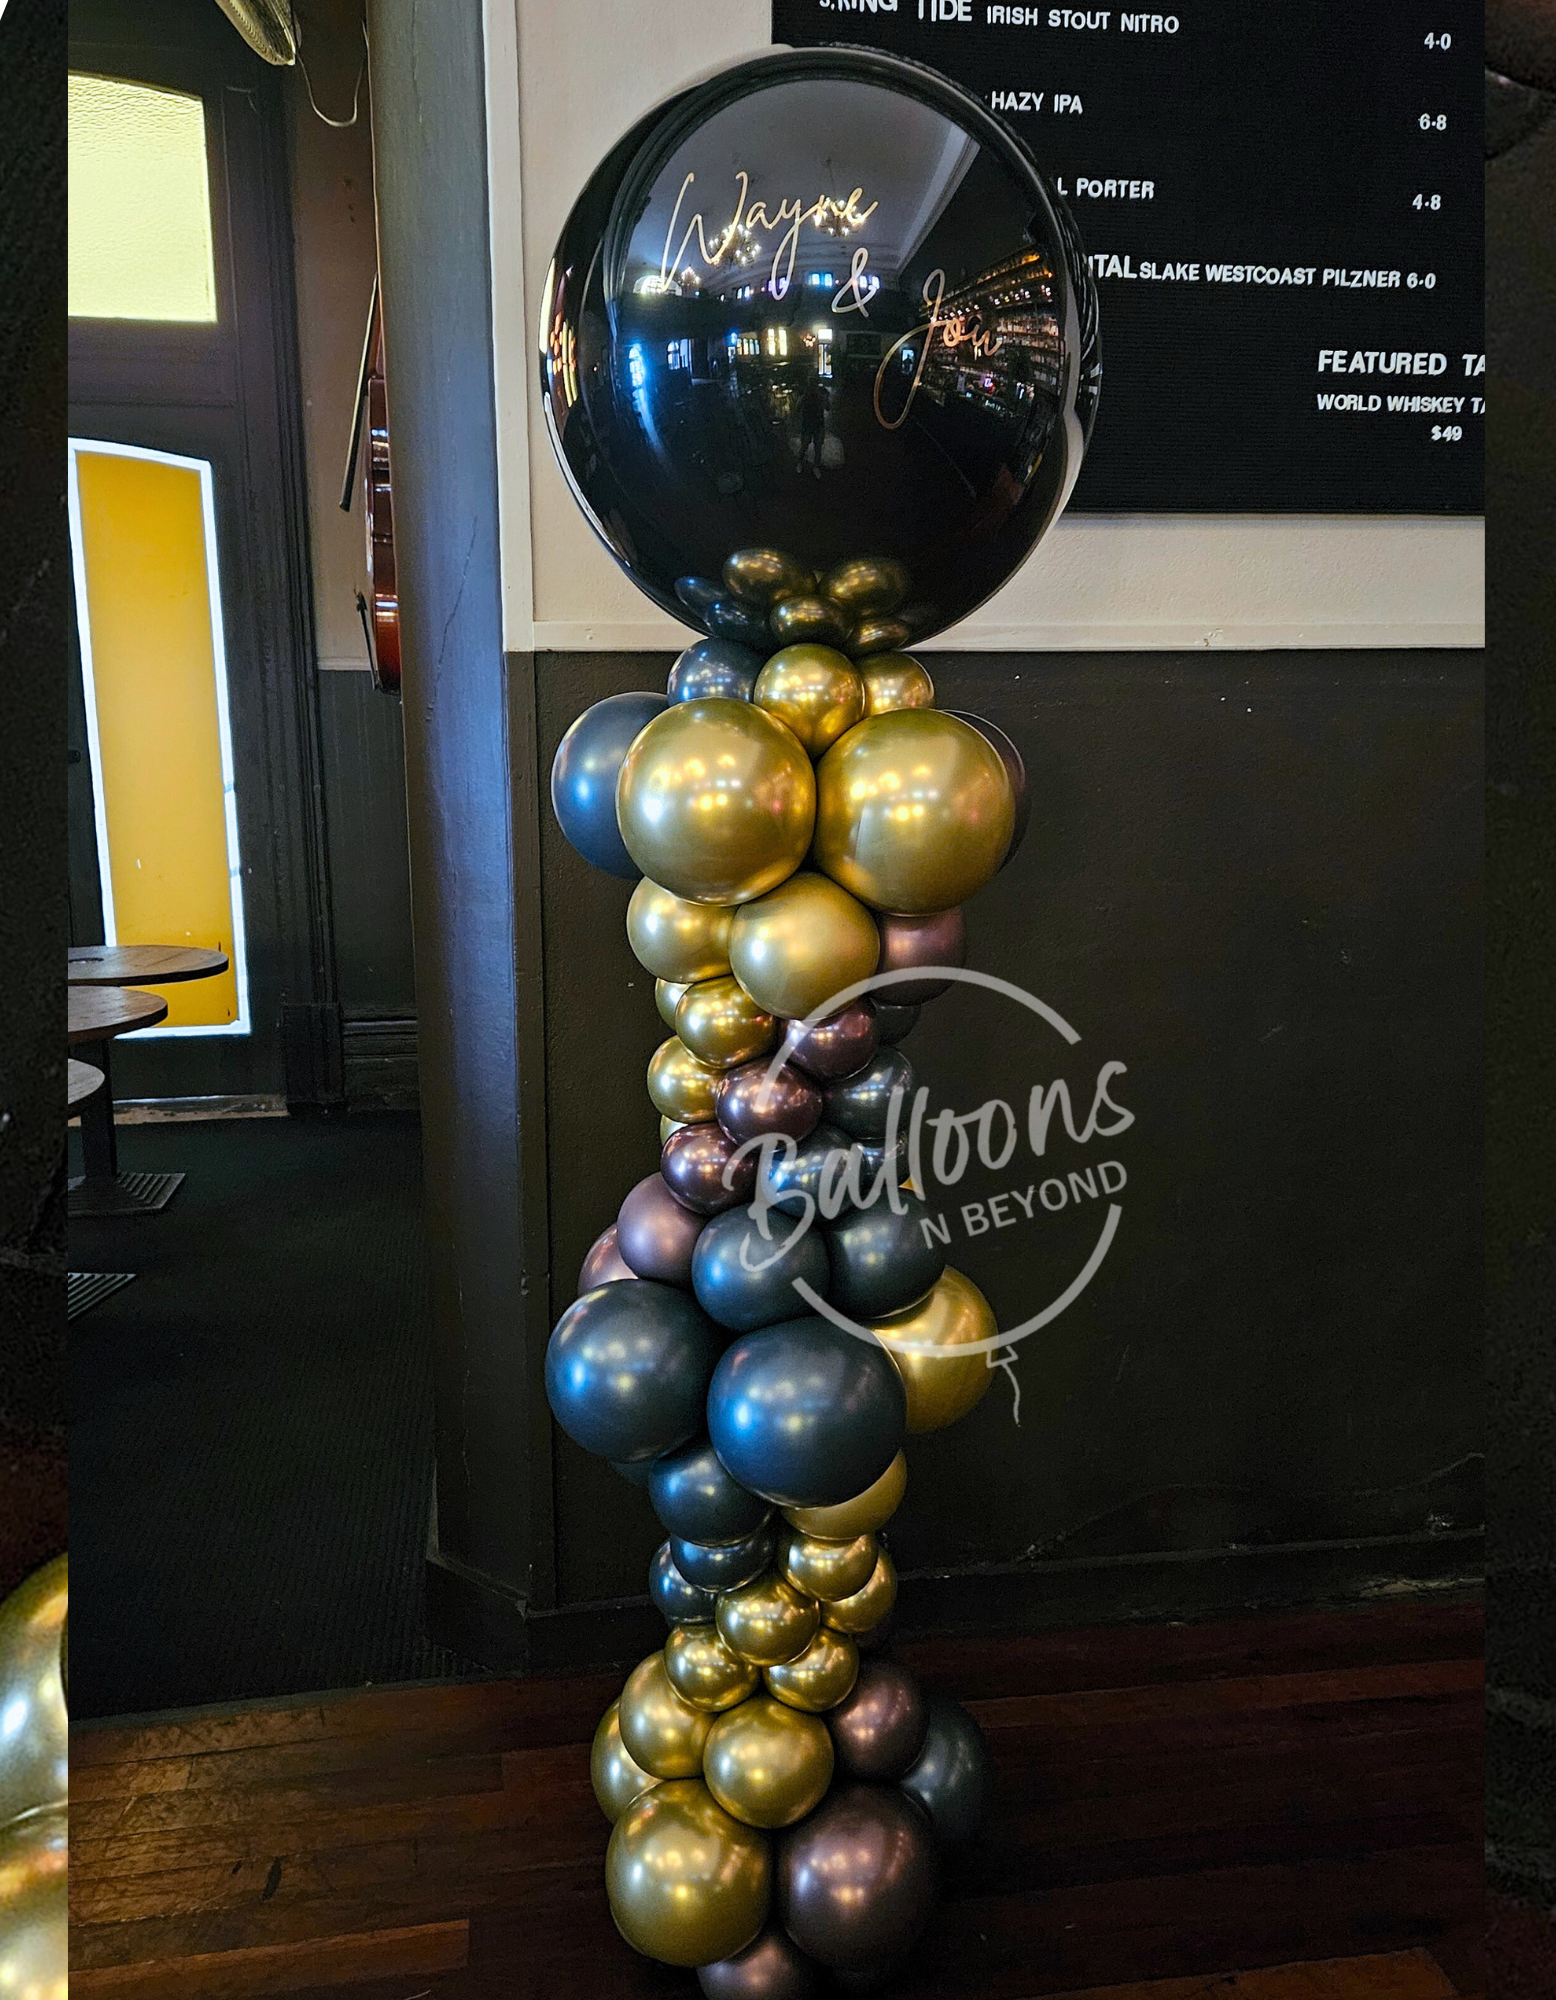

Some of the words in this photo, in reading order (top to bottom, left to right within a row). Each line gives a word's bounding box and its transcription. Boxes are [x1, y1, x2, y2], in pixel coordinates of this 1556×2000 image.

[917, 0, 973, 22] TIDE
[986, 6, 1039, 26] IRISH
[1048, 9, 1110, 31] STOUT
[1120, 13, 1180, 34] NITRO
[991, 90, 1044, 112] HAZY
[1053, 94, 1083, 114] IPA
[1076, 178, 1155, 199] PORTER
[661, 171, 878, 301] Wayne
[831, 247, 877, 318] &
[1139, 261, 1200, 281] SLAKE
[1205, 263, 1316, 286] WESTCOAST
[1322, 268, 1401, 288] PILZNER
[1317, 350, 1447, 376] FEATURED
[1317, 394, 1381, 412] WORLD
[1387, 395, 1465, 413] WHISKEY
[1431, 425, 1463, 442] $49
